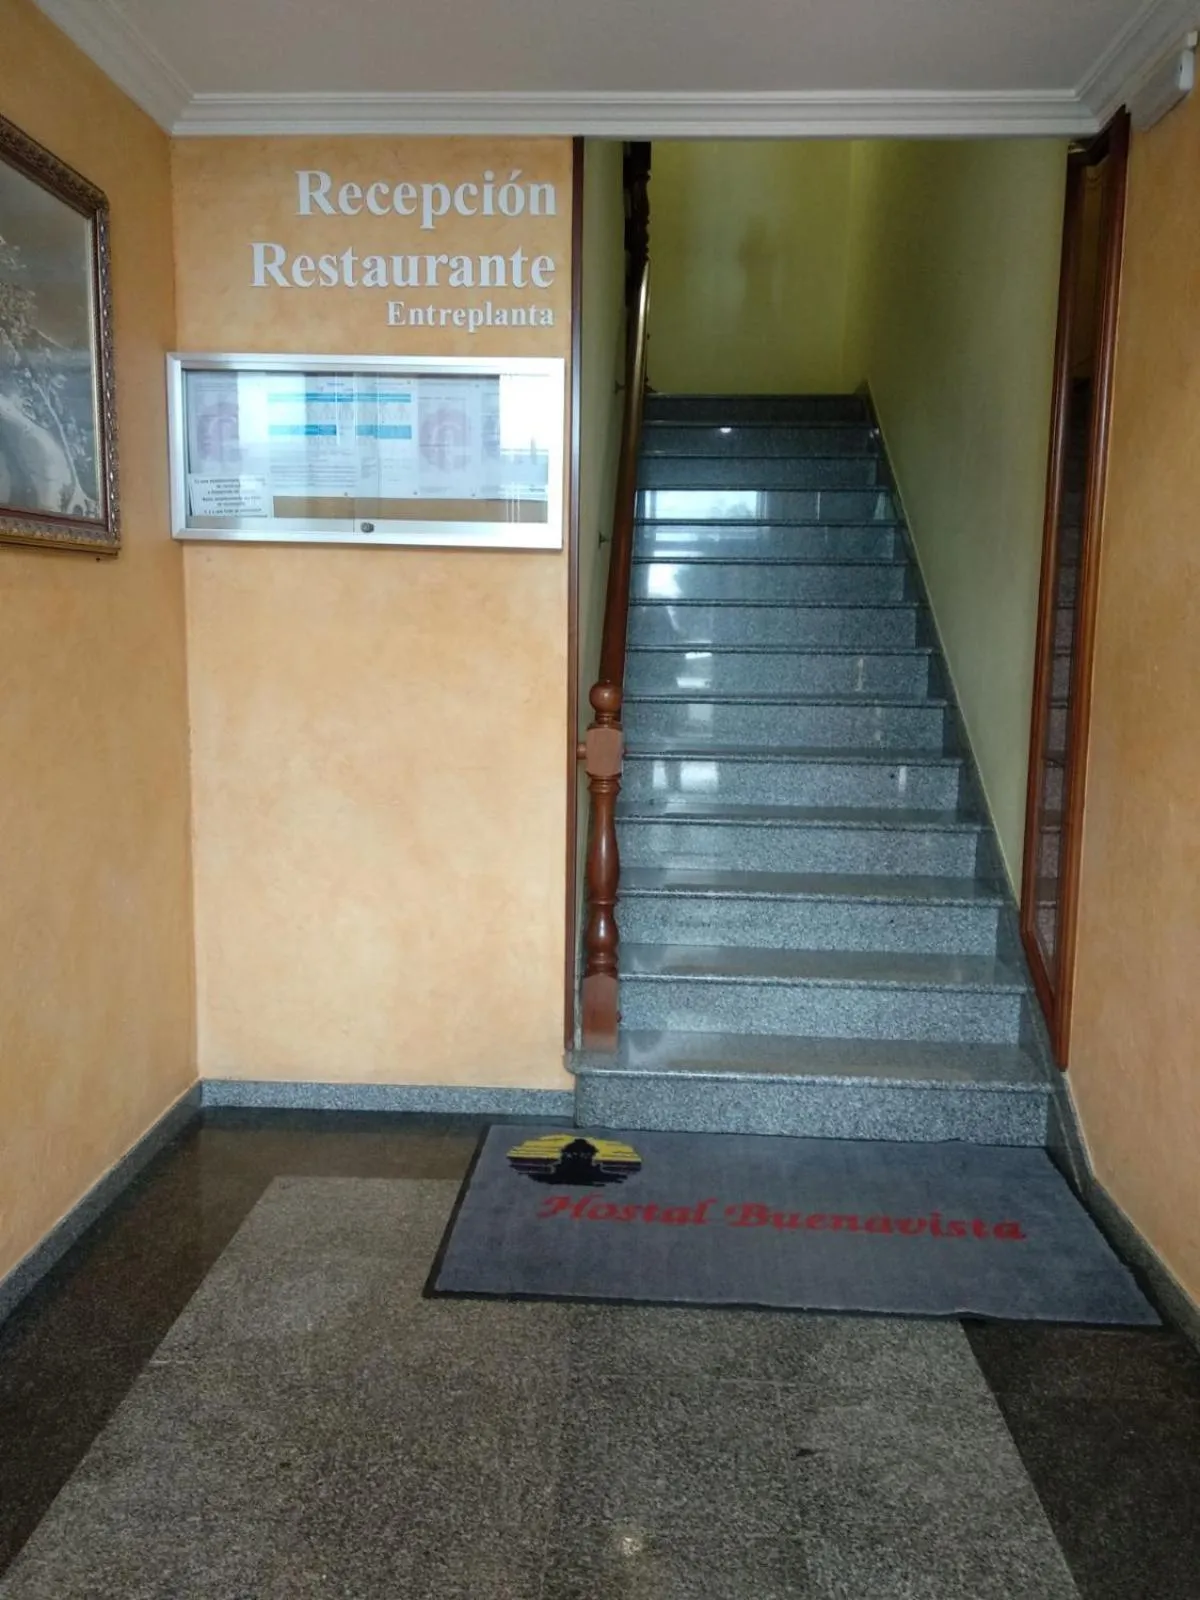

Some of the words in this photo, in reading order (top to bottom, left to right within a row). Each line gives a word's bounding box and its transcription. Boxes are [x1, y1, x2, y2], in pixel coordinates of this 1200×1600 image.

[295, 169, 557, 229] Recepción
[250, 242, 556, 288] Restaurante
[386, 300, 555, 333] Entreplanta
[536, 1194, 718, 1228] Hostal
[724, 1202, 1028, 1241] Buenavista
